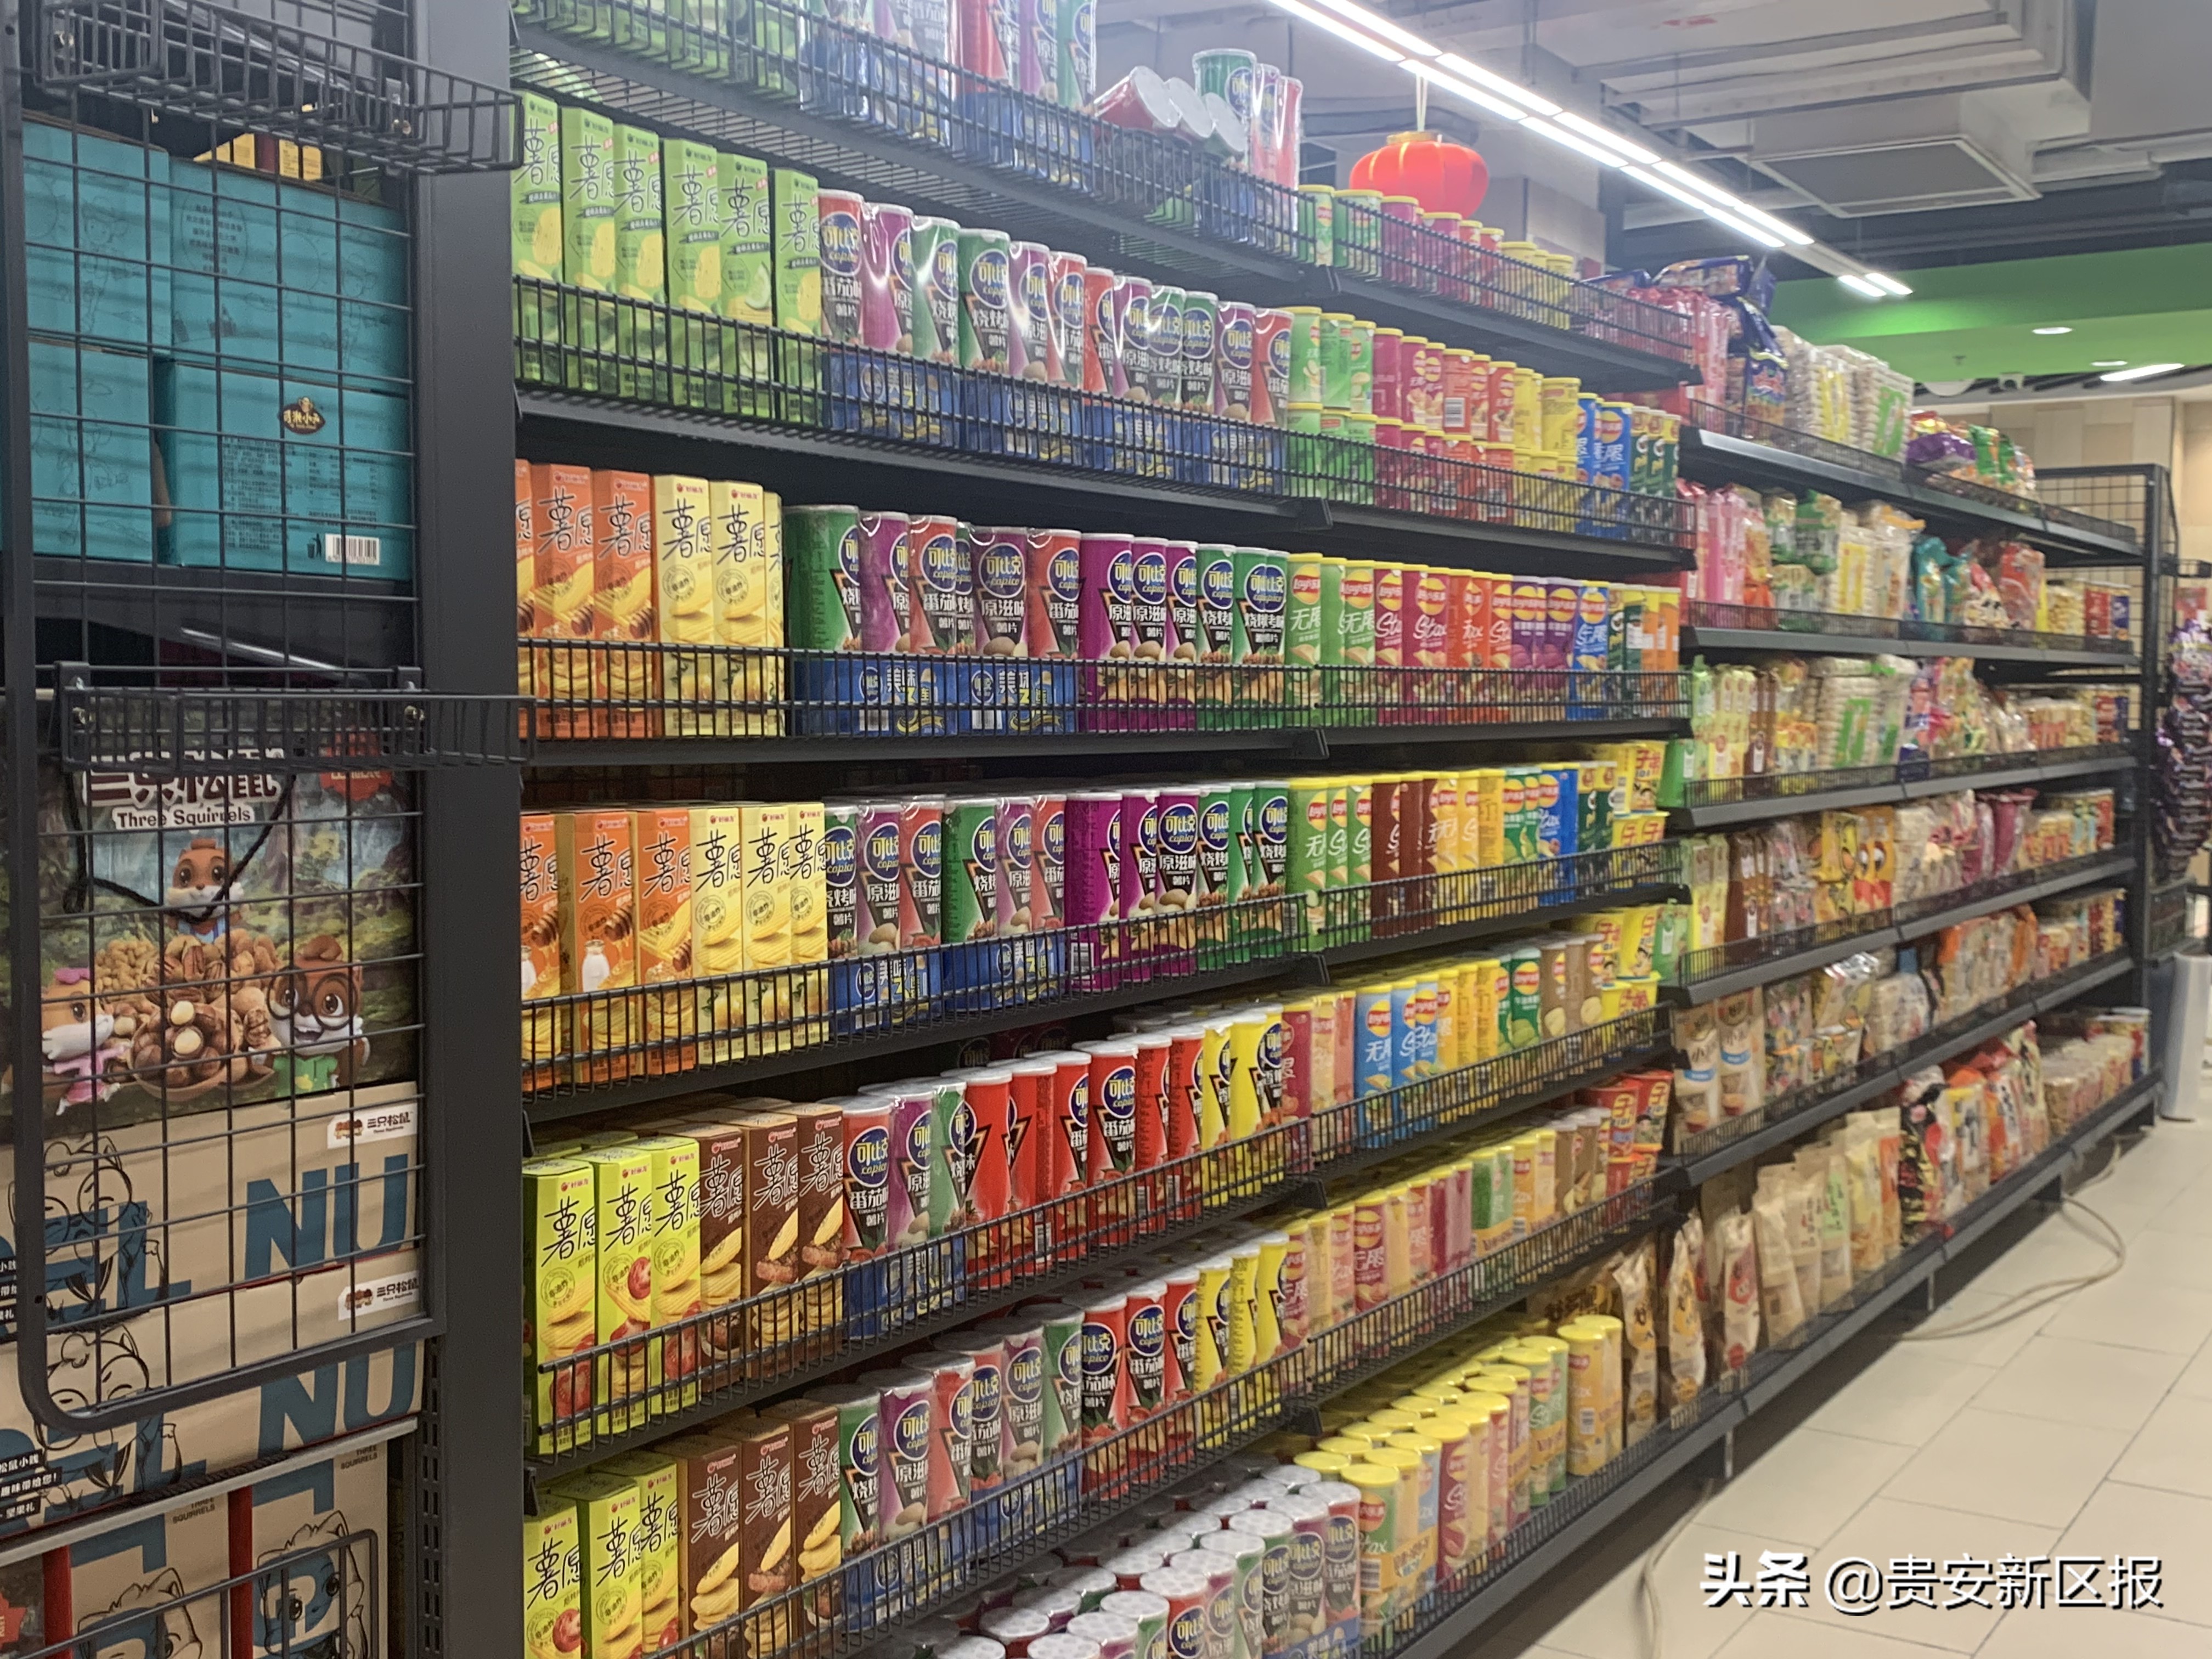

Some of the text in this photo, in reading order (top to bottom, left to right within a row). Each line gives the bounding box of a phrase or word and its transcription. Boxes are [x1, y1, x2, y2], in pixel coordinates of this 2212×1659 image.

[984, 555, 1022, 578] 可比克
[1138, 564, 1166, 586] 可比克
[981, 599, 1024, 618] 原滋味
[117, 811, 167, 828] Three
[1165, 814, 1196, 836] 可比克
[825, 837, 855, 865] 可比克
[1159, 854, 1197, 871] 原滋味
[867, 883, 900, 902] 原滋
[367, 1112, 410, 1128] 三只松鼠
[856, 1137, 889, 1166] 可比克
[173, 1503, 215, 1523] SQUIRRELS
